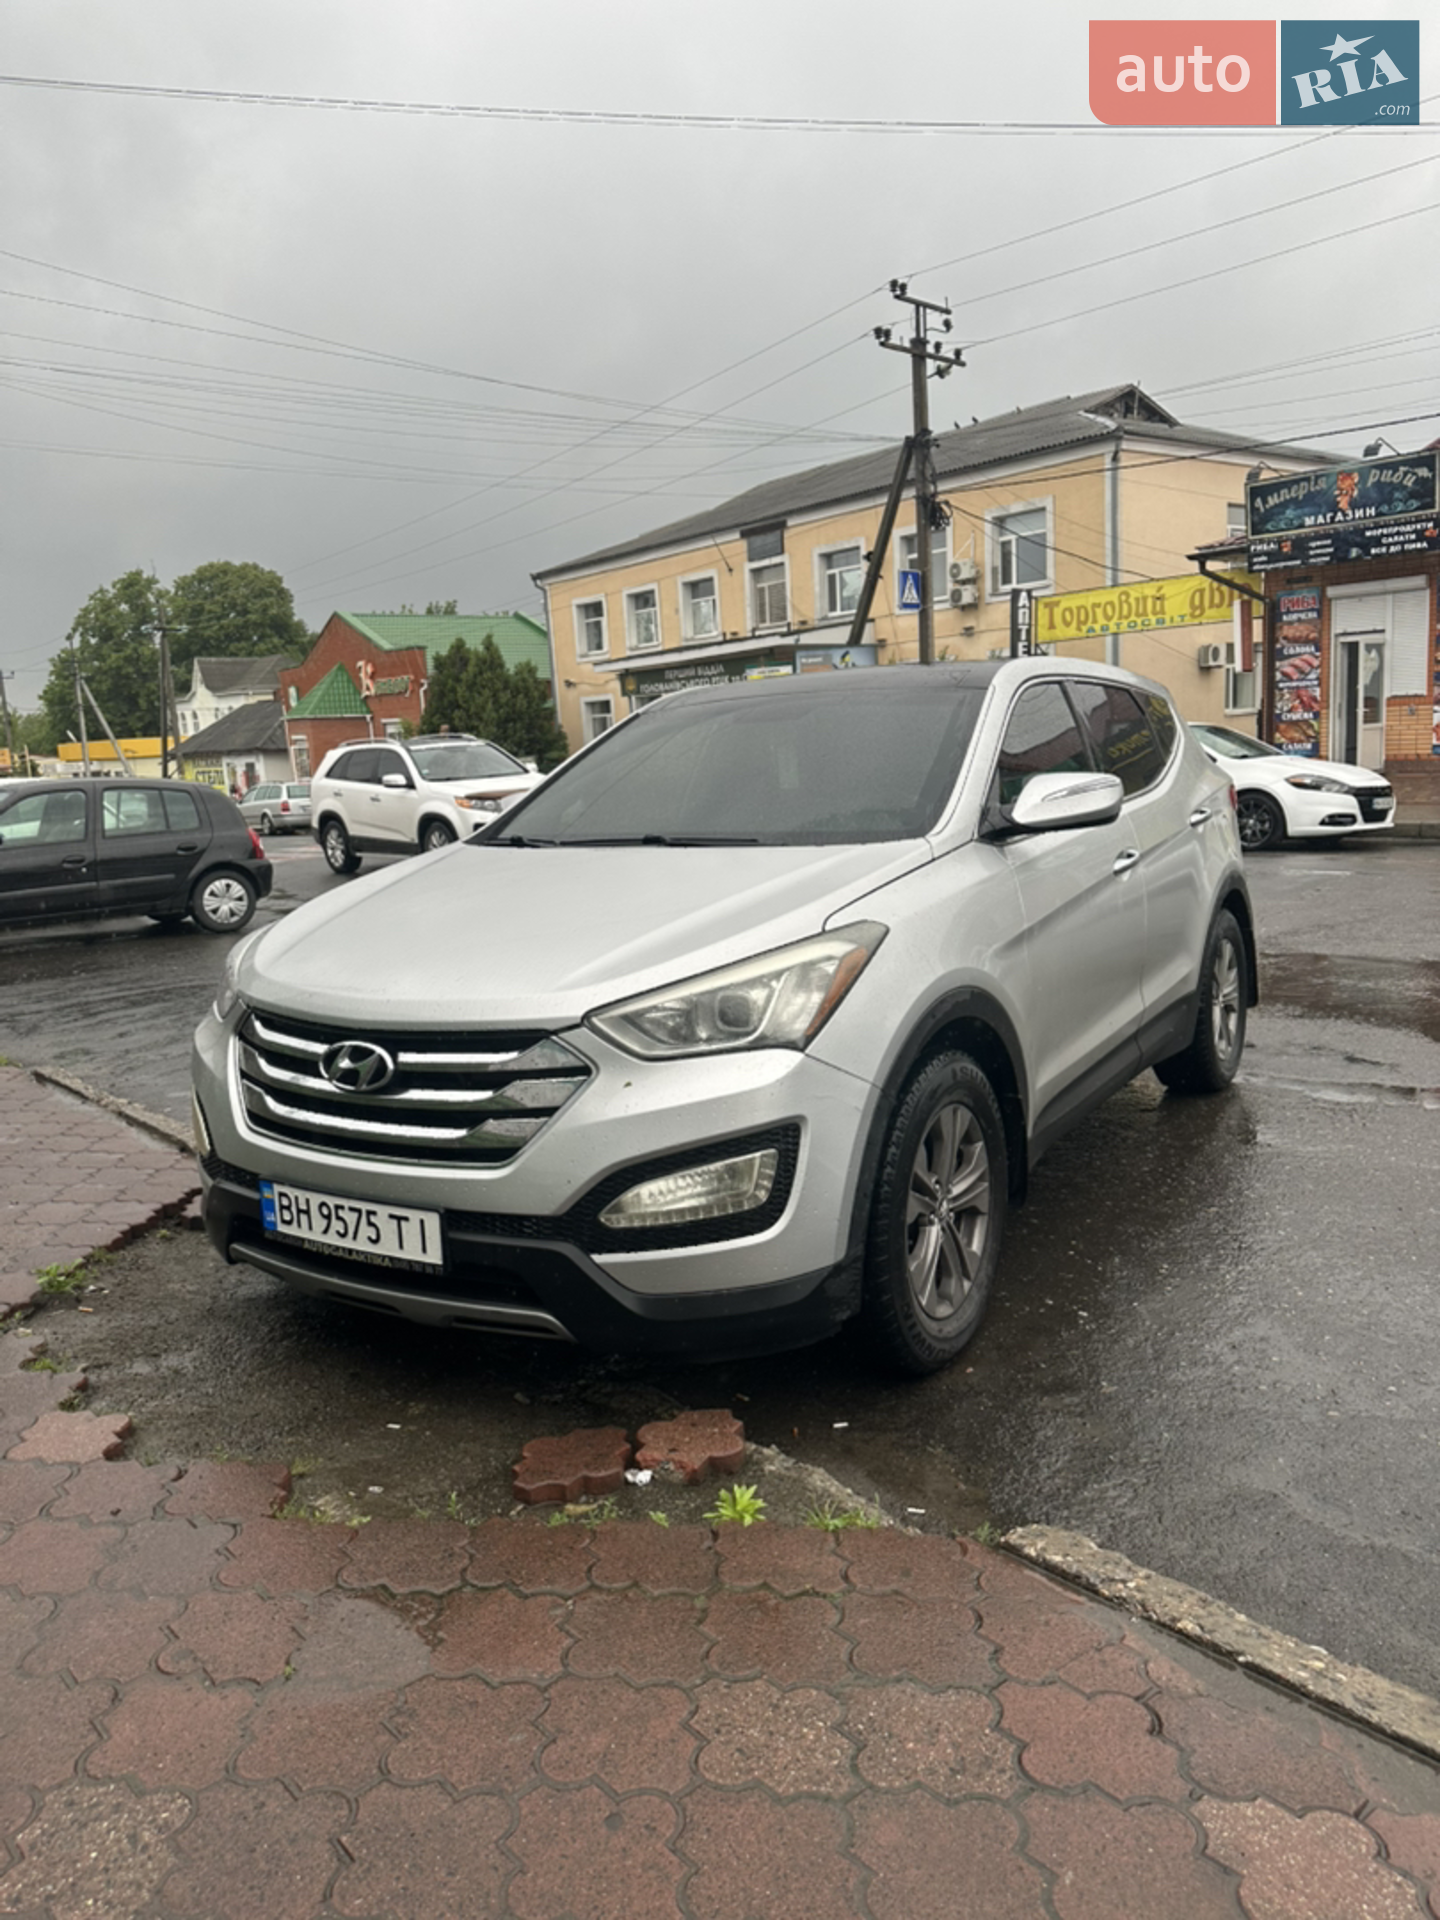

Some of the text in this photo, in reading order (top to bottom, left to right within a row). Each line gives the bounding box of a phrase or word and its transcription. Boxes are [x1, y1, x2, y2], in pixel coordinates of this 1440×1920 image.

[1304, 506, 1376, 527] МАГАЗИН
[1389, 544, 1402, 554] ДО
[1280, 594, 1318, 612] РИБА
[1086, 614, 1188, 634] АВТОСВІТ
[277, 1191, 313, 1231] BH
[318, 1201, 381, 1245] 9575
[303, 1239, 392, 1268] AUTOGALAKTIKA
